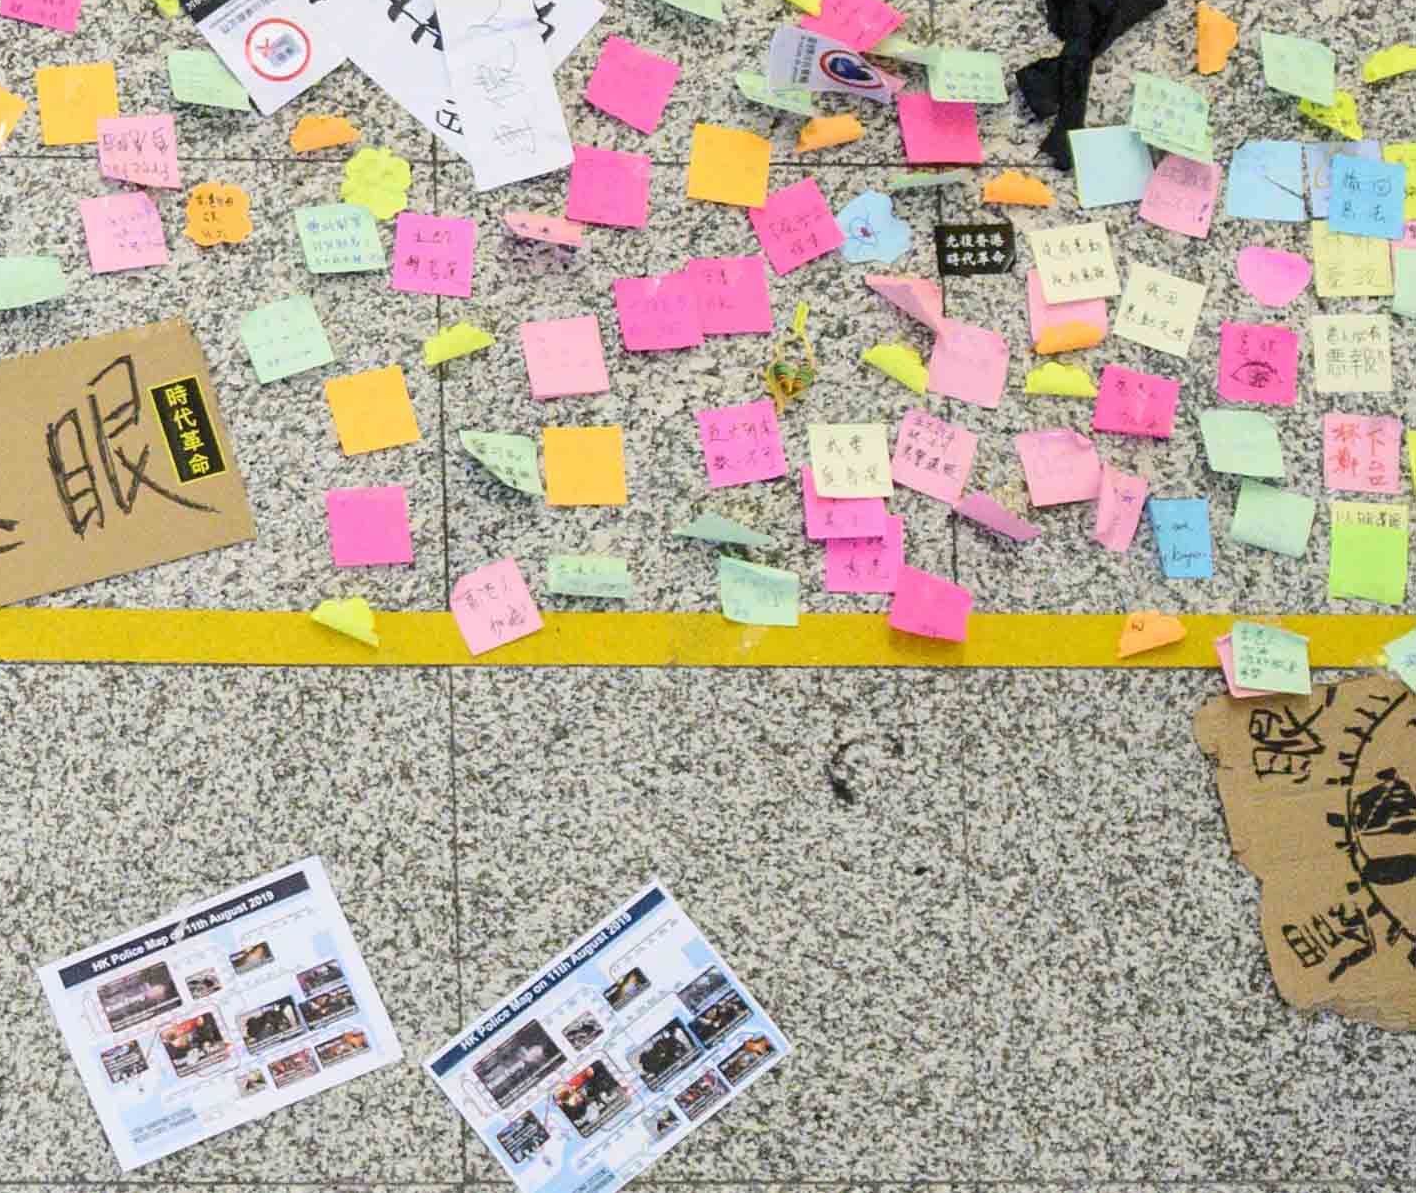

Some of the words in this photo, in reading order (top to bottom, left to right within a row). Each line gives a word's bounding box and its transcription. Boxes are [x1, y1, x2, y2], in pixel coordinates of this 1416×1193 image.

[944, 248, 1007, 266] 時代革命
[164, 381, 214, 481] 時代革命
[90, 955, 113, 974] HK
[109, 941, 146, 966] Police
[143, 931, 170, 954] Map
[183, 915, 209, 935] 11th
[207, 899, 250, 927] August
[246, 887, 276, 910] 2019
[458, 1032, 480, 1052] HK
[476, 1006, 513, 1038] Police
[531, 978, 549, 996] on
[545, 958, 573, 983] 11th
[567, 929, 611, 968] August
[604, 910, 634, 937] 2019
